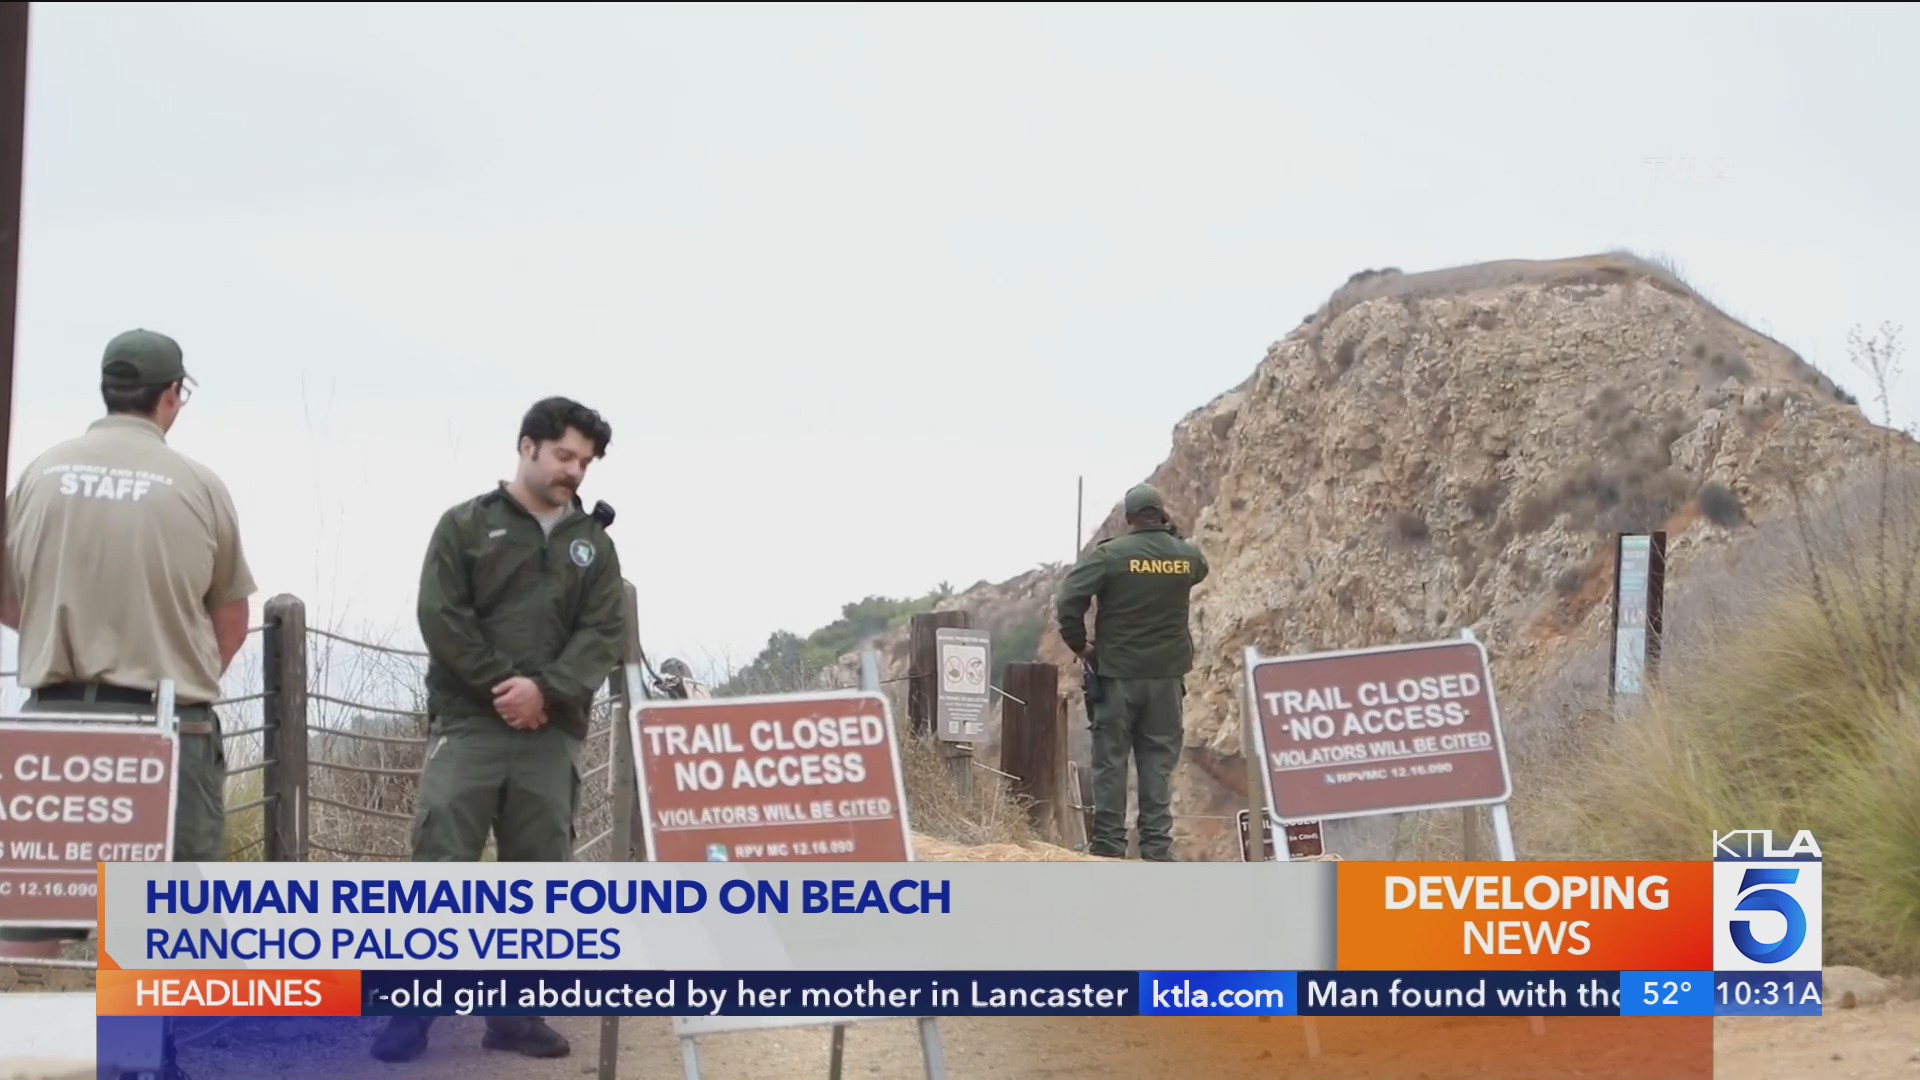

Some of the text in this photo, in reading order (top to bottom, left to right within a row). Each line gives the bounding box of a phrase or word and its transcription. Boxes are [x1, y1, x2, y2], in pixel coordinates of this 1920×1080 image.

[60, 473, 150, 501] STAFF
[109, 468, 133, 477] AND
[135, 471, 173, 485] TRAILS
[1129, 559, 1191, 574] RANGER
[1264, 673, 1480, 716] TRAIL CLOSED
[643, 715, 884, 756] TRAIL CLOSED
[1290, 702, 1465, 741] NO ACCESS
[1272, 731, 1491, 768] VIOLATORS WILL BE CITED
[14, 754, 164, 784] CLOSED
[674, 752, 866, 792] NO ACCESS
[658, 798, 891, 827] VIOLATORS WILL BE CITED
[10, 841, 59, 860] WILL
[65, 843, 93, 861] BE
[98, 843, 158, 862] CITED
[18, 882, 98, 896] 12.16.090
